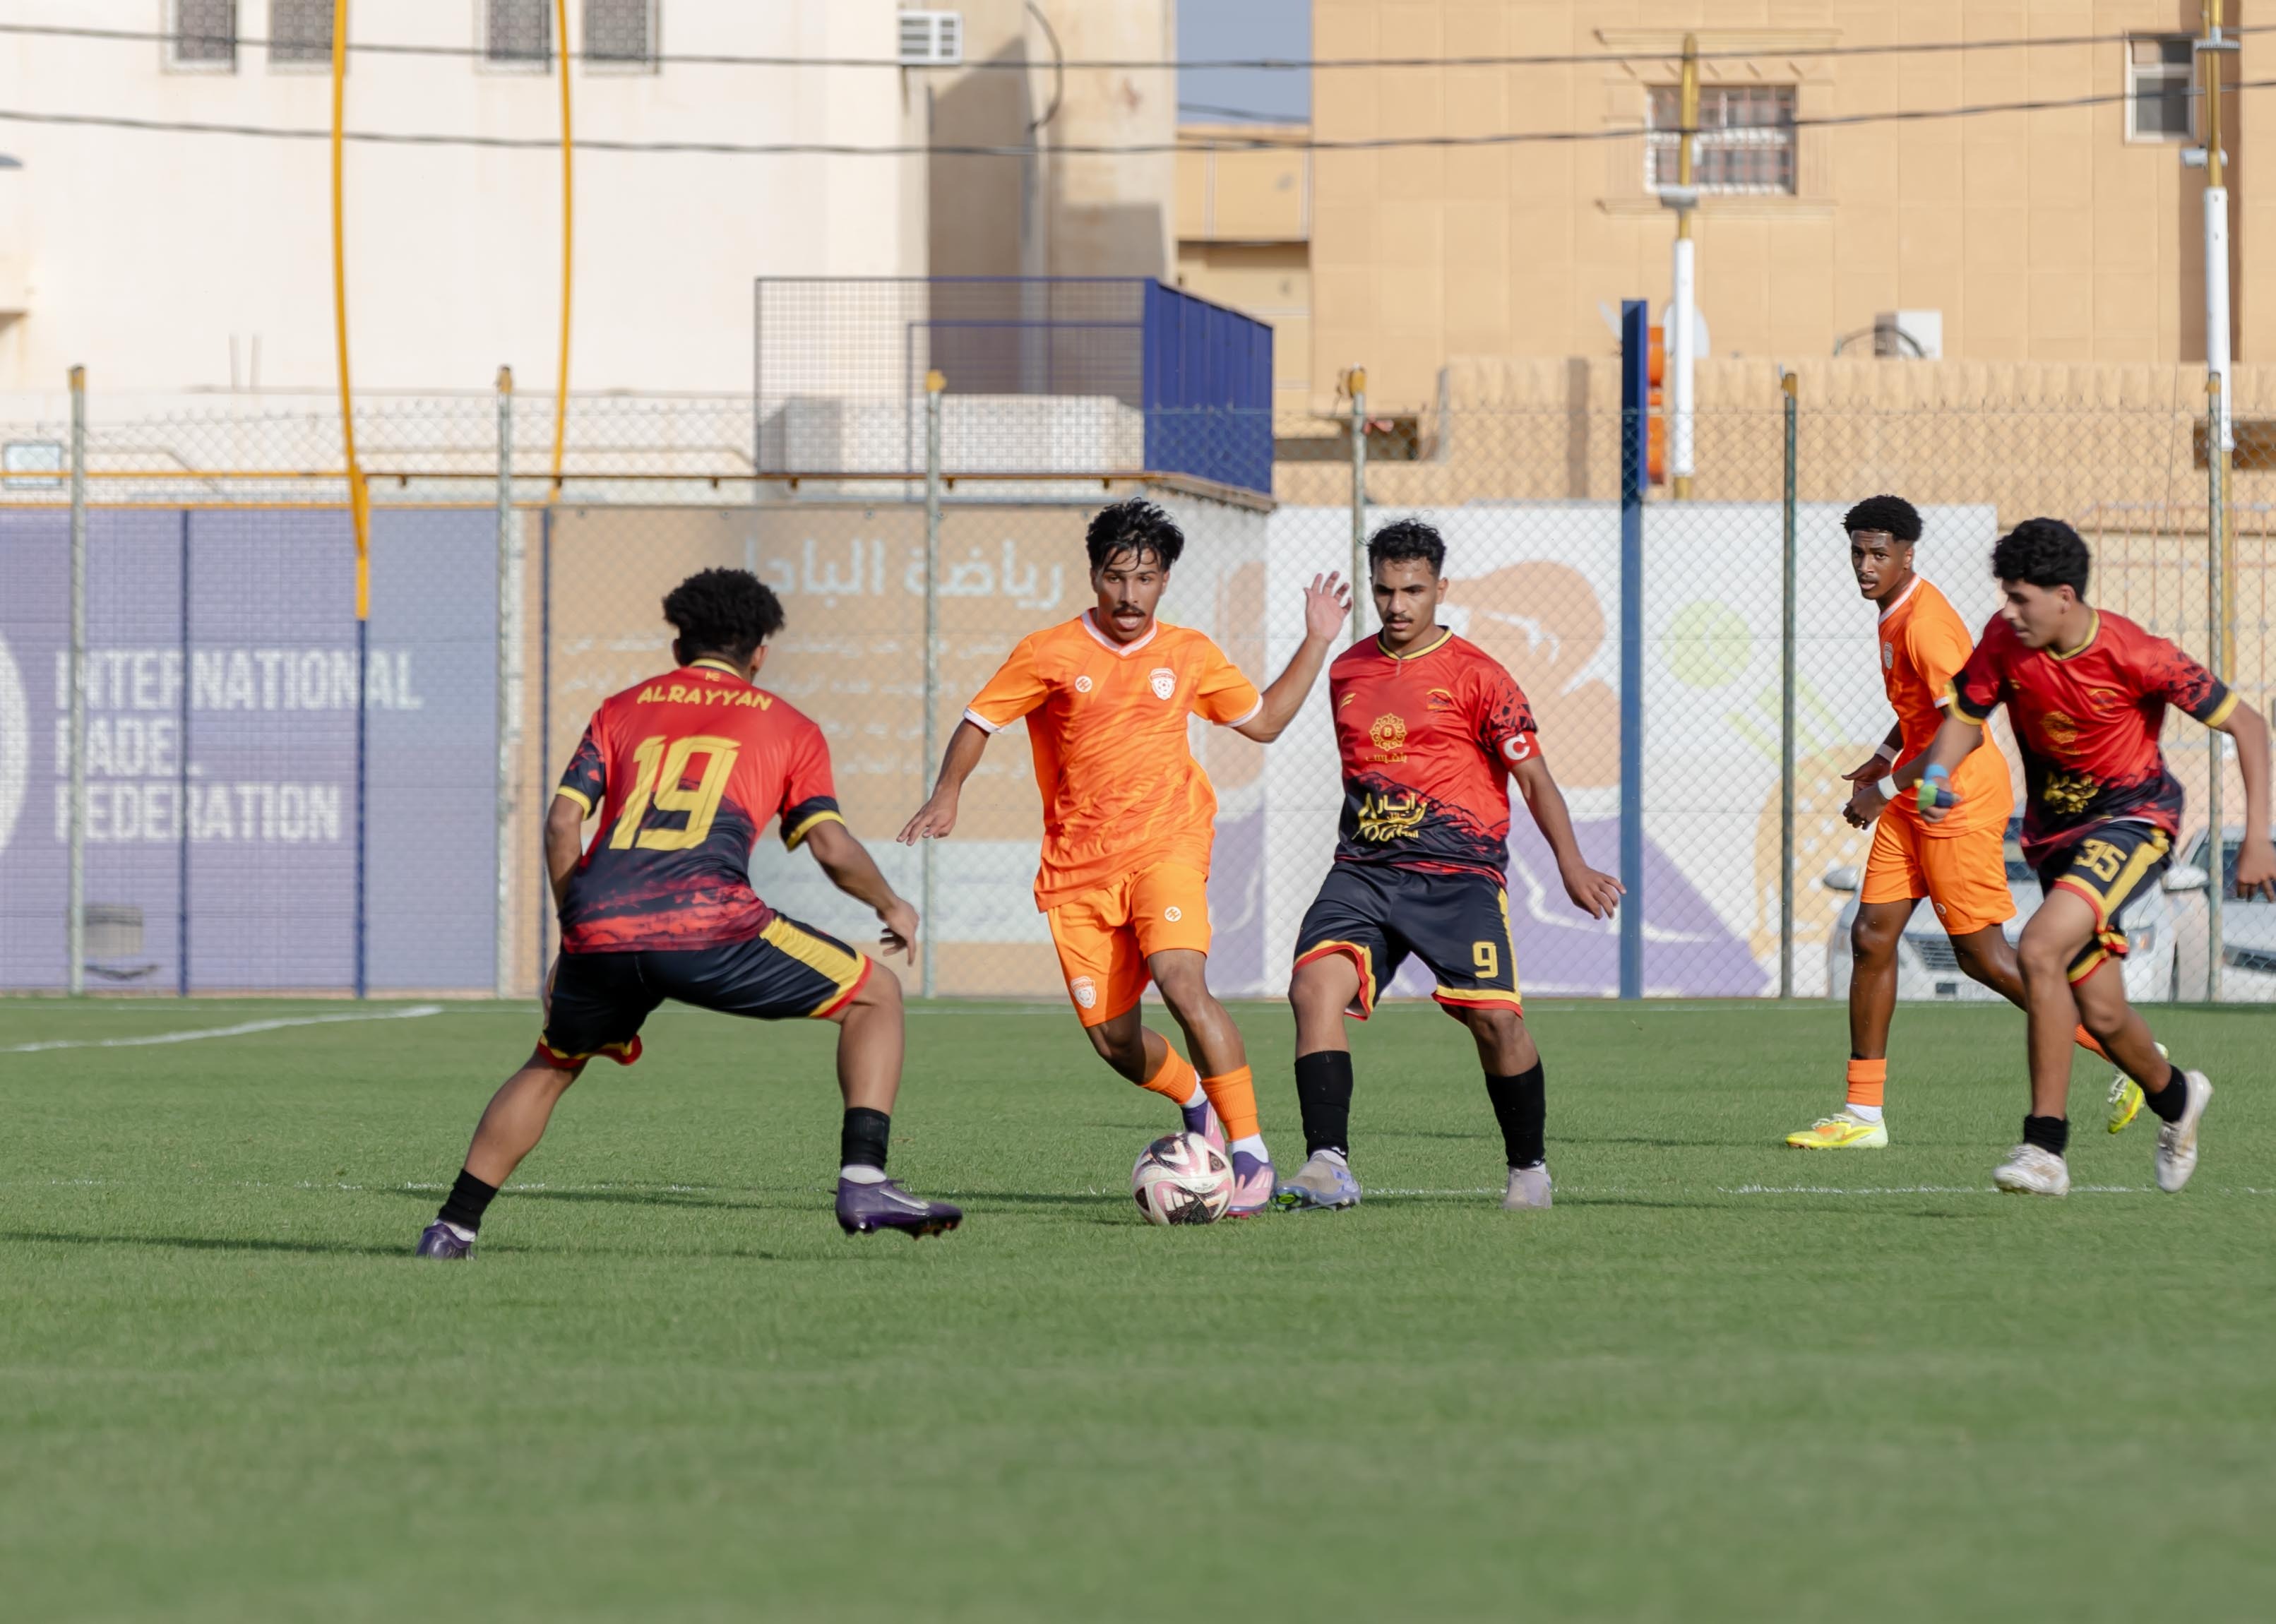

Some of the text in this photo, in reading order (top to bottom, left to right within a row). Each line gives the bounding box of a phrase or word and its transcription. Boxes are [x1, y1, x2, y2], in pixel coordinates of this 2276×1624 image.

[637, 684, 773, 712] ALRAYYAN
[1503, 733, 1531, 760] C
[609, 734, 742, 852] 19
[1472, 941, 1499, 979] 9
